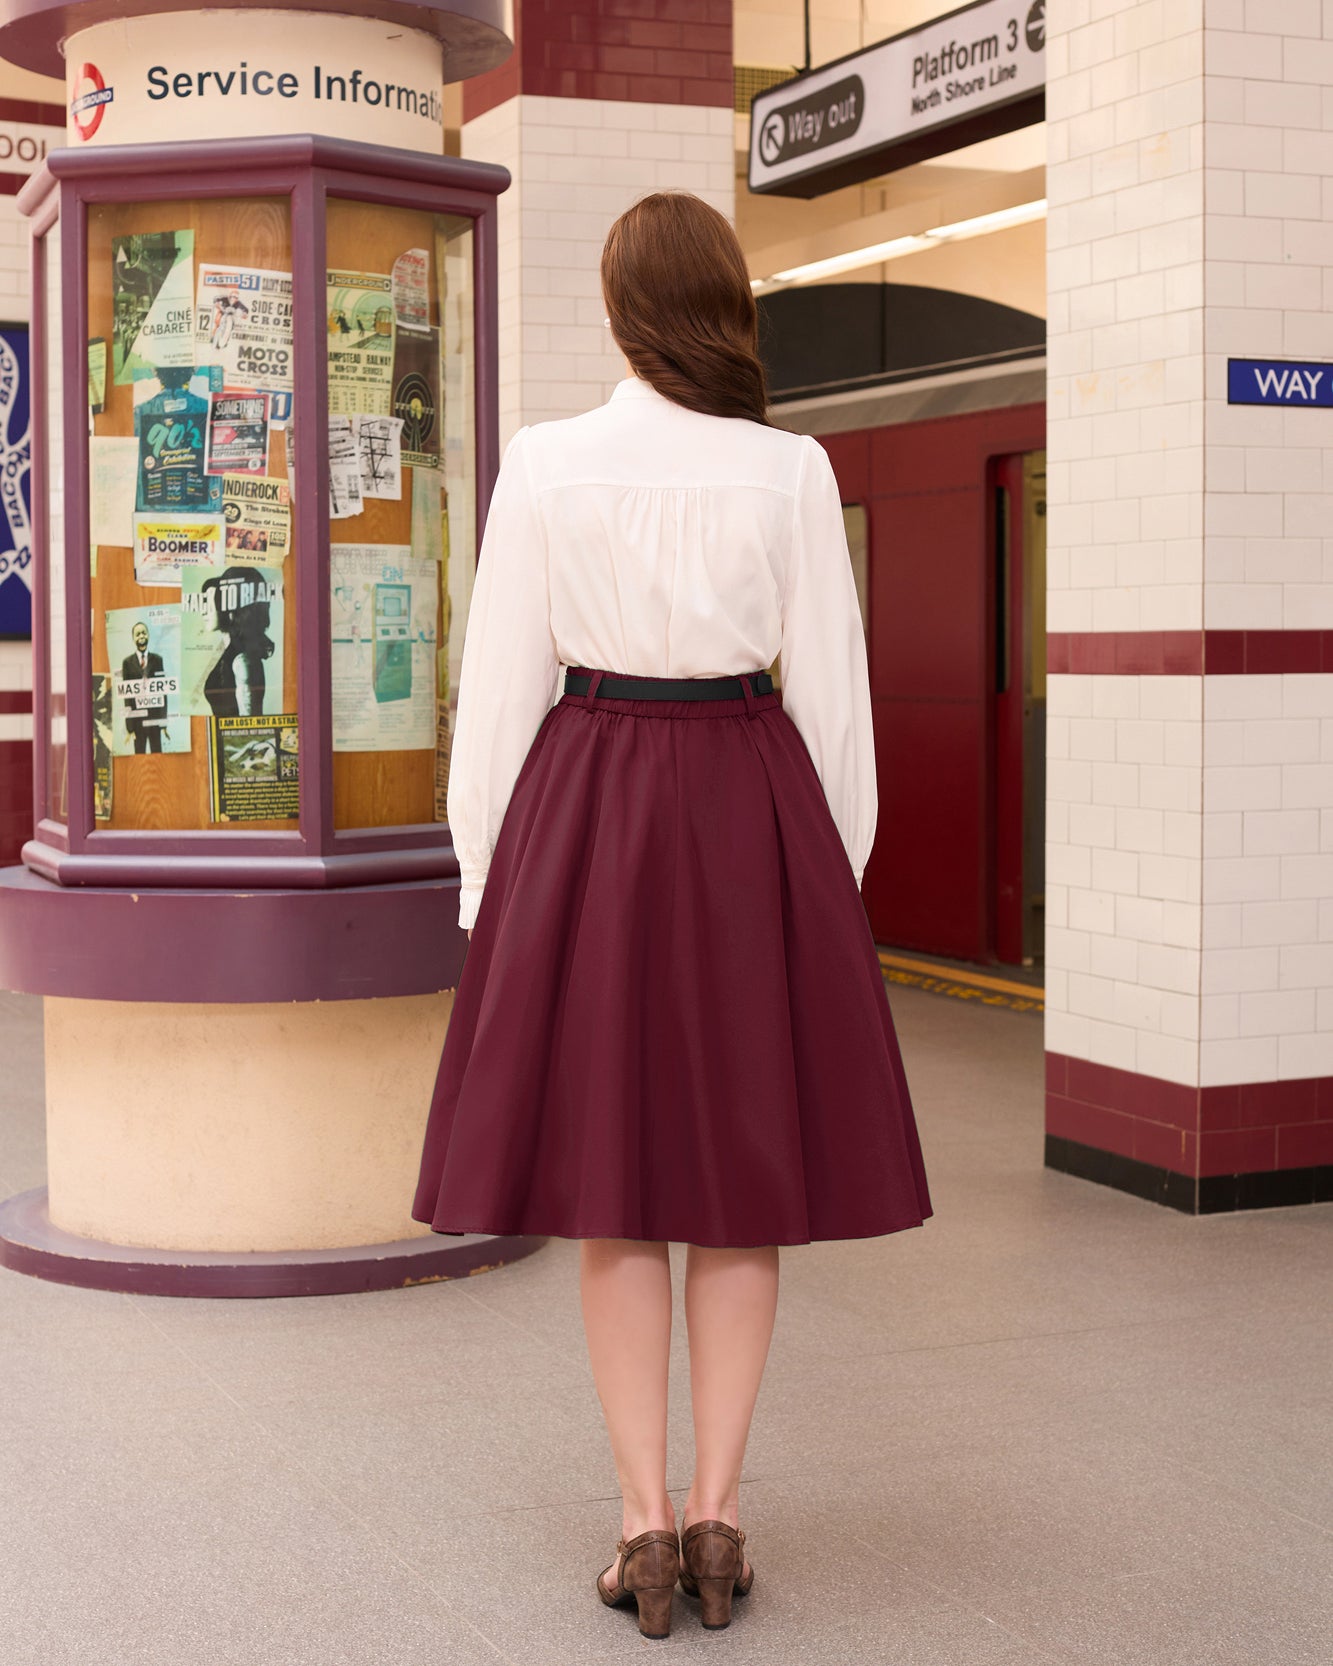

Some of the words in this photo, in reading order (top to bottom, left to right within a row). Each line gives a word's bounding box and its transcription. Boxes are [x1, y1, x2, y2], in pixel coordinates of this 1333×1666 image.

[912, 34, 998, 89] Platform
[1007, 18, 1018, 52] 3
[147, 61, 299, 100] Service
[314, 65, 443, 126] Informati
[911, 87, 942, 116] North
[945, 77, 984, 101] Shore
[989, 64, 1017, 87] Line
[788, 110, 824, 143] Way
[828, 92, 856, 128] out
[241, 275, 258, 289] 51
[166, 307, 192, 322] CINÉ
[251, 300, 274, 315] SIDE
[142, 322, 193, 336] CABARET
[199, 314, 210, 331] 12
[251, 315, 292, 328] CROS
[238, 345, 289, 363] MOTO
[328, 351, 362, 364] AMPSTEAD
[236, 360, 288, 377] CROSS
[1254, 368, 1324, 400] WAY
[223, 479, 279, 500] INDIEROCK
[224, 505, 239, 518] 29
[148, 536, 209, 554] BOOMER
[219, 584, 238, 612] TO
[240, 581, 284, 608] BLACK
[137, 697, 162, 706] VOICE
